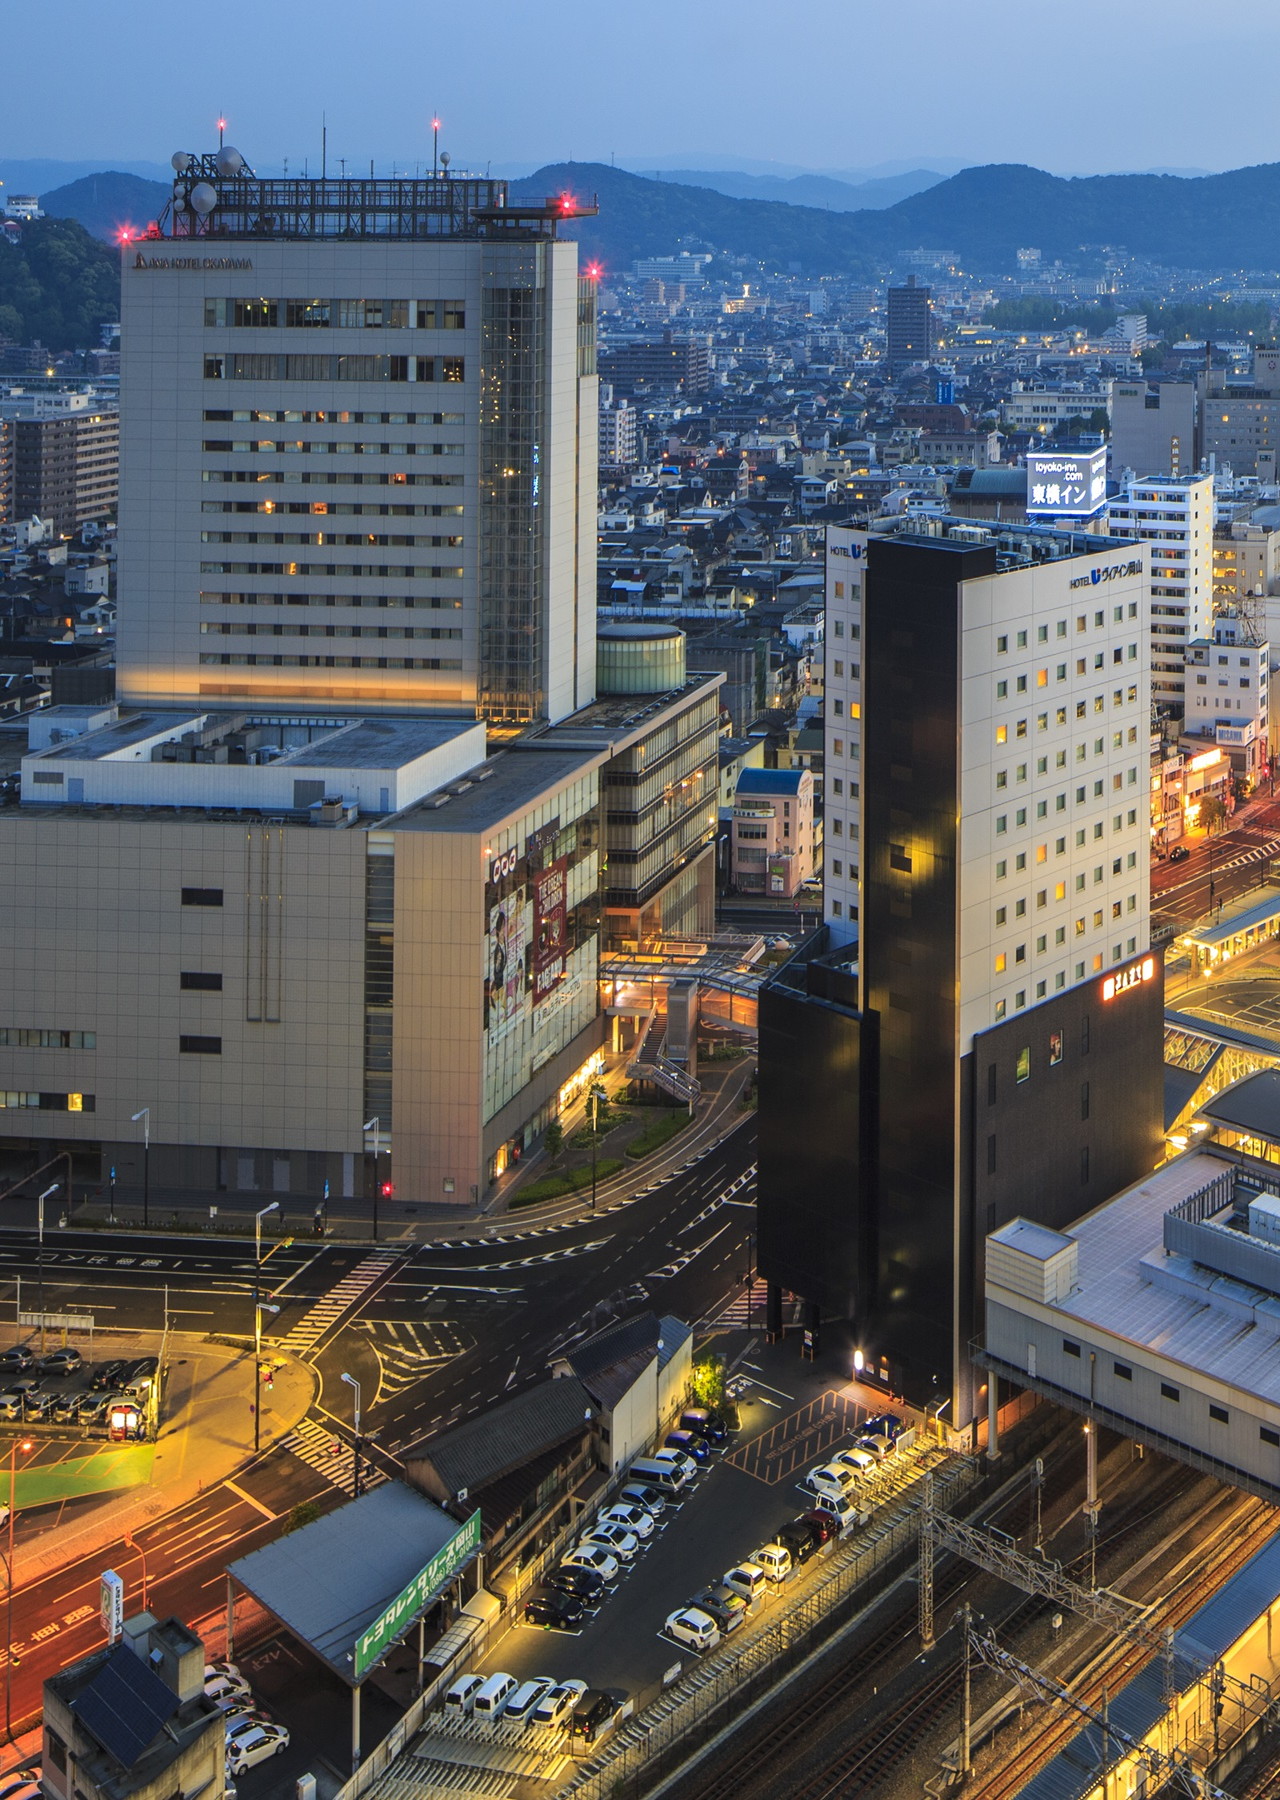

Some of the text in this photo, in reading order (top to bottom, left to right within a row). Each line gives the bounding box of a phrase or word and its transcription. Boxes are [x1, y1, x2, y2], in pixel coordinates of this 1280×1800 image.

[149, 256, 253, 270] ANA HOTEL OKAYAMA
[1035, 461, 1078, 474] toyoko-inn
[1063, 472, 1083, 481] .com
[1032, 483, 1086, 504] 東横イン
[830, 545, 851, 557] HOTEL
[1070, 576, 1091, 590] HOTEL
[429, 1537, 474, 1593] (086) 254-0100
[362, 1521, 475, 1655] トヨタレンタリース岡山
